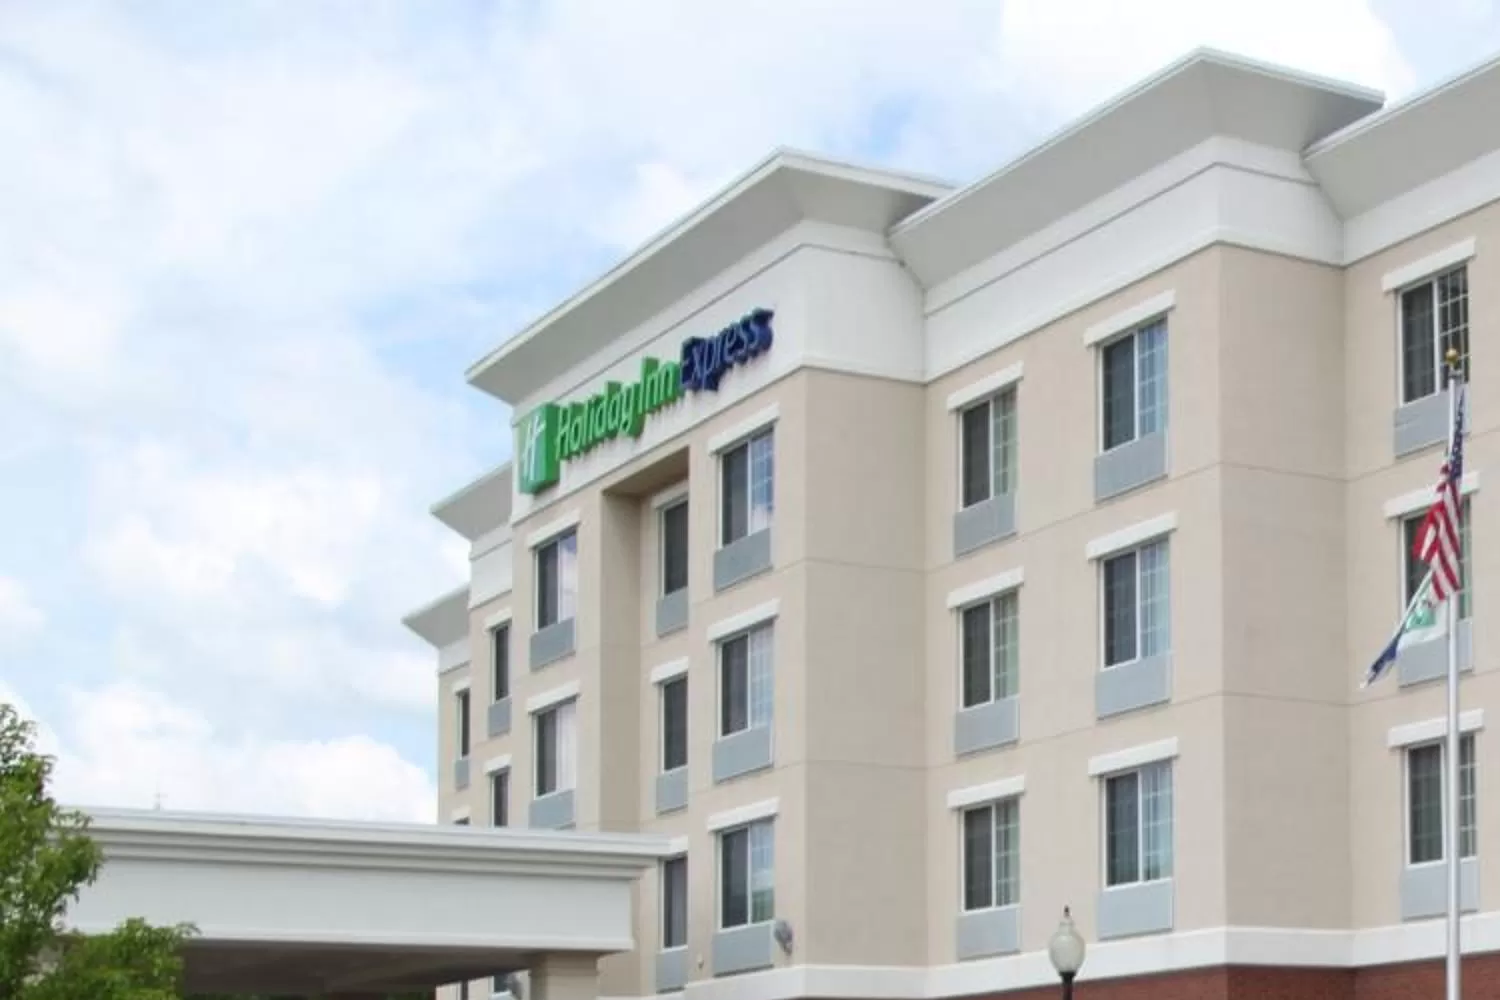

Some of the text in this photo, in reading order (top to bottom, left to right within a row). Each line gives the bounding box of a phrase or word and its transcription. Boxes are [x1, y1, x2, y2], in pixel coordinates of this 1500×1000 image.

[556, 380, 639, 461] Holiday
[638, 357, 680, 415] Inn
[680, 308, 773, 393] Express
